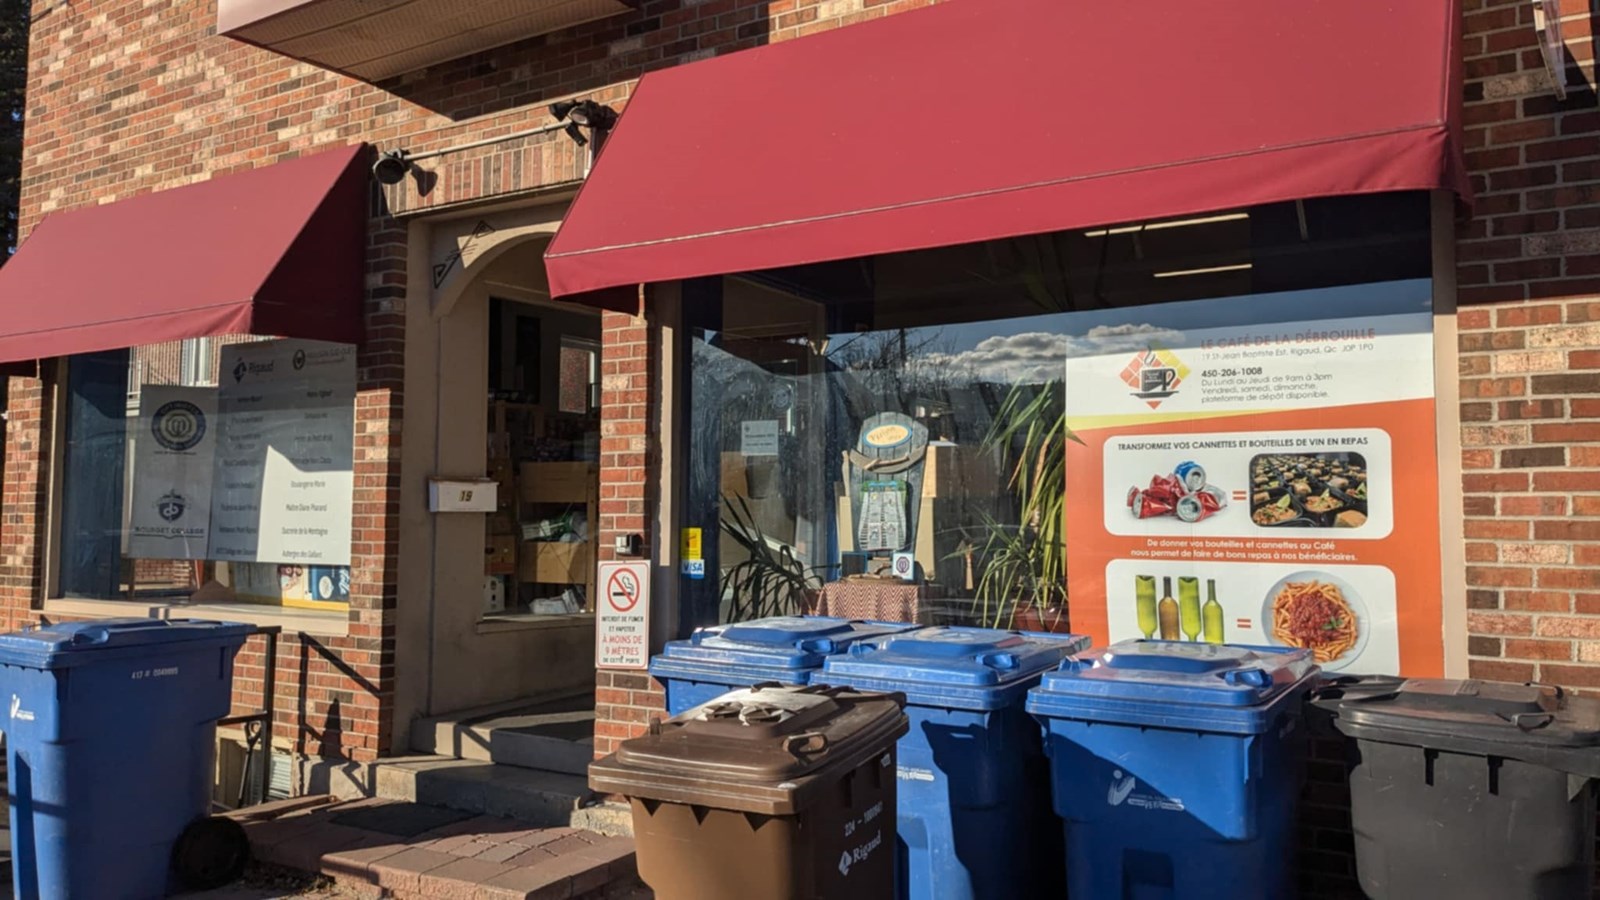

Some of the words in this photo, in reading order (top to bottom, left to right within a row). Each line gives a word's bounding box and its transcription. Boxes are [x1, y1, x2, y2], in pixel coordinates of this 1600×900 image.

[1201, 339, 1213, 350] LE
[1217, 335, 1251, 349] CAFÉ
[1254, 335, 1272, 346] DE
[1275, 334, 1291, 345] LA
[1295, 327, 1376, 344] DÉBROUILLE
[1242, 349, 1275, 360] Baptiste
[1324, 345, 1337, 355] Qc
[1201, 366, 1263, 378] 450-206-1008
[1201, 378, 1213, 387] Du
[1213, 377, 1235, 387] Lundi
[1271, 375, 1283, 384] de
[1285, 374, 1304, 382] 9am
[1313, 372, 1333, 382] 3pm
[1201, 394, 1245, 404] plateforme
[1245, 394, 1257, 402] de
[1258, 391, 1284, 402] dépôt
[1117, 441, 1172, 451] TRANSFORMEZ
[1173, 441, 1191, 450] VOS
[1191, 439, 1238, 450] CANNETTES
[1238, 439, 1248, 448] ET
[1249, 438, 1295, 448] BOUTEILLES
[1295, 437, 1307, 447] DE
[1308, 437, 1326, 446] VIN
[1327, 437, 1339, 446] EN
[1340, 436, 1369, 446] REPAS
[459, 490, 473, 502] 19
[1147, 538, 1158, 548] De
[1159, 539, 1189, 548] donner
[1189, 540, 1204, 548] vos
[1205, 539, 1245, 549] bouteilles
[1245, 540, 1255, 549] et
[1255, 540, 1298, 550] cannettes
[1299, 542, 1312, 550] au
[1313, 540, 1336, 551] Café
[1130, 549, 1150, 557] nous
[1150, 548, 1180, 559] permet
[1181, 548, 1192, 558] de
[1193, 548, 1212, 558] faire
[1212, 549, 1224, 559] de
[1225, 549, 1246, 559] bons
[1247, 551, 1273, 562] repas
[1281, 552, 1298, 561] nos
[1298, 550, 1358, 562] bénéficiaires.
[683, 562, 703, 572] VISA
[608, 635, 632, 645] MOINS
[633, 635, 643, 645] DE
[852, 829, 882, 864] Rigaud
